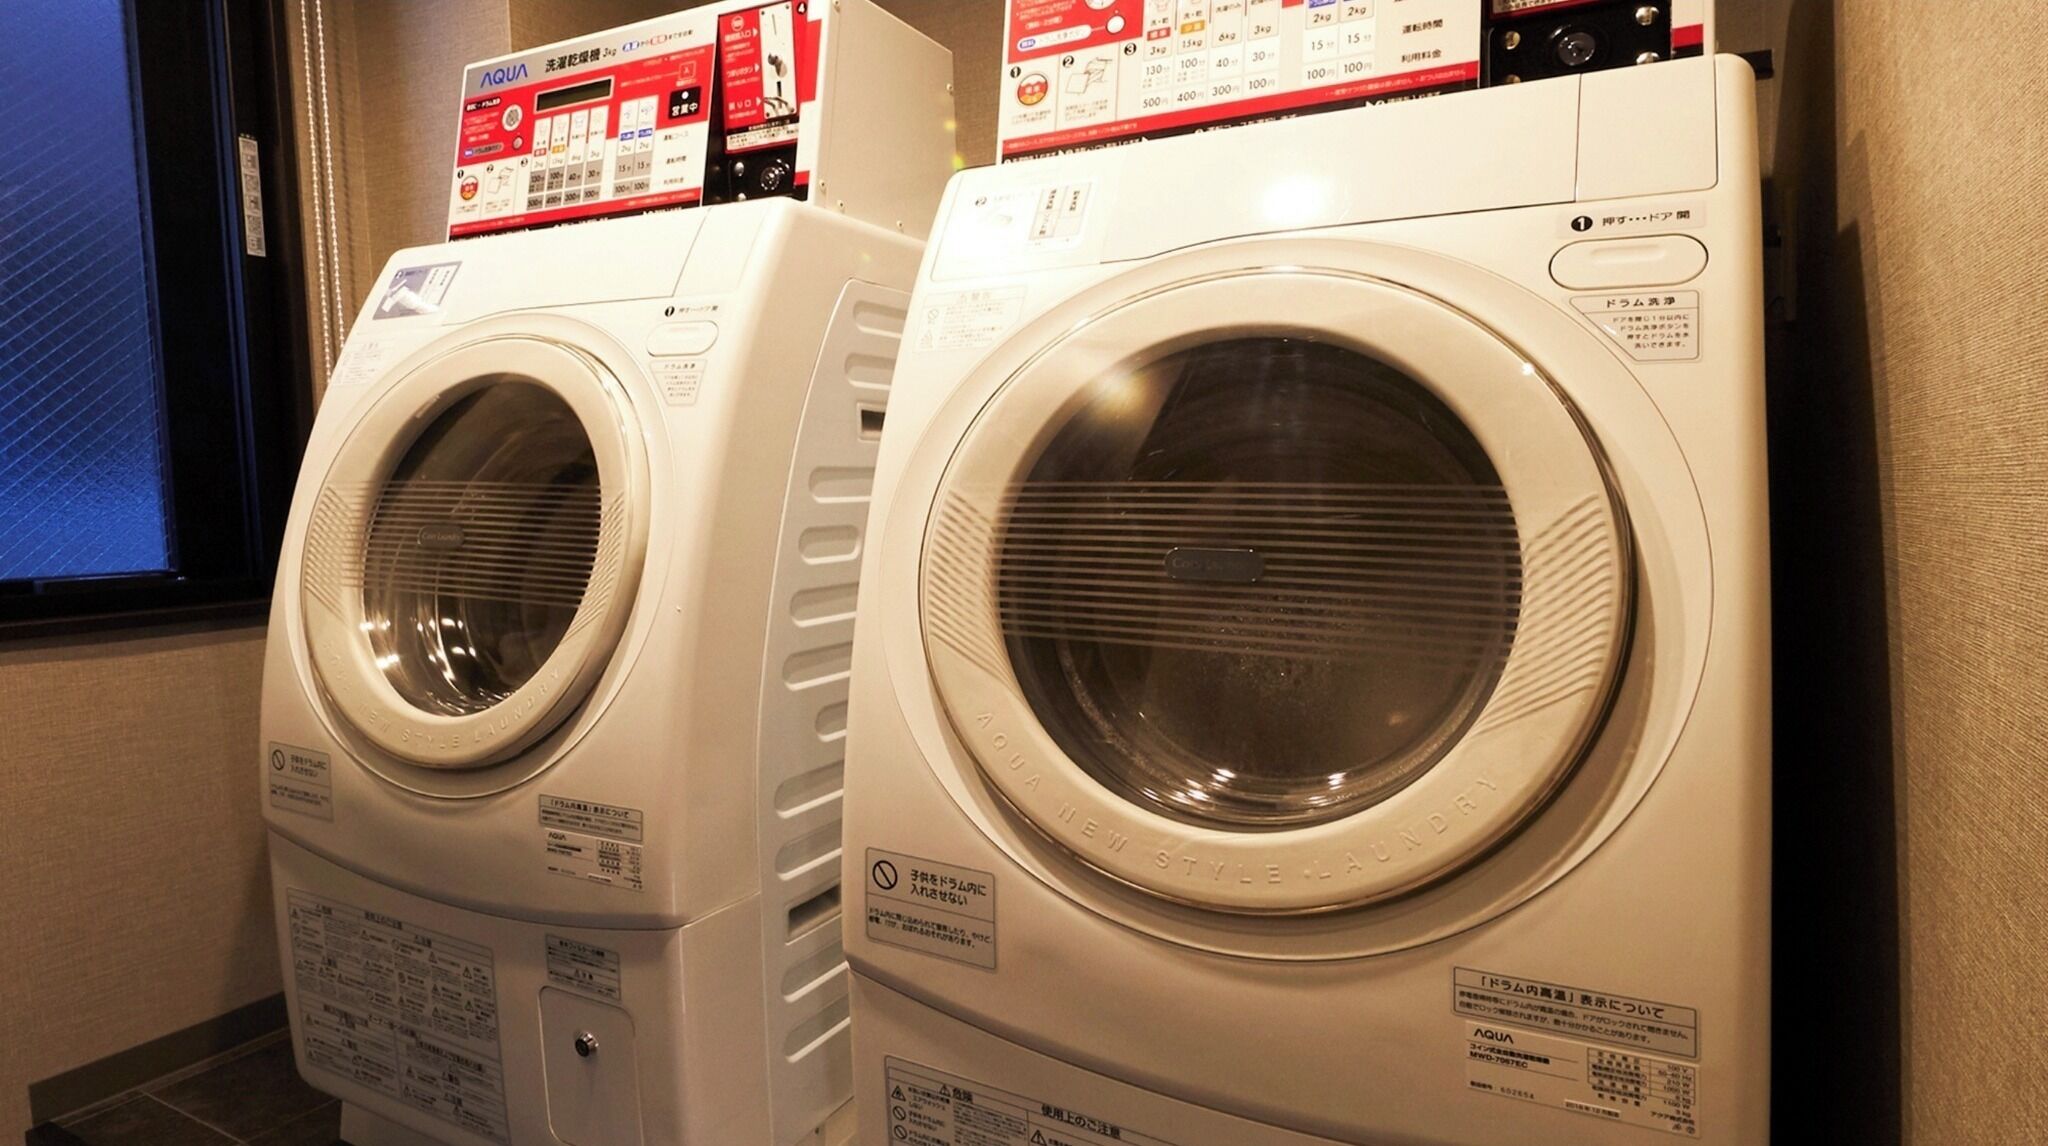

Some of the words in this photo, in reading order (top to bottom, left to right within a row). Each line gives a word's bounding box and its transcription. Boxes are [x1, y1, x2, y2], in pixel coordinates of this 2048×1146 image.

[1254, 25, 1271, 35] 3kg
[1313, 13, 1331, 24] 2kg
[1347, 6, 1366, 17] 2kg
[545, 48, 600, 73] 洗濯乾燥機
[480, 63, 528, 88] AQUA
[671, 102, 698, 117] 営業中
[1606, 296, 1676, 308] ドラム洗浄
[976, 711, 1042, 793] AQUA
[1058, 802, 1128, 854] NEW
[1155, 849, 1281, 885] STYLE
[1317, 774, 1499, 881] LAUNDRY
[910, 868, 987, 896] 子供をドラム内に
[910, 883, 968, 905] 入れさせない
[1474, 1028, 1515, 1045] AQUA
[1041, 1103, 1120, 1140] 使用上のご注意
